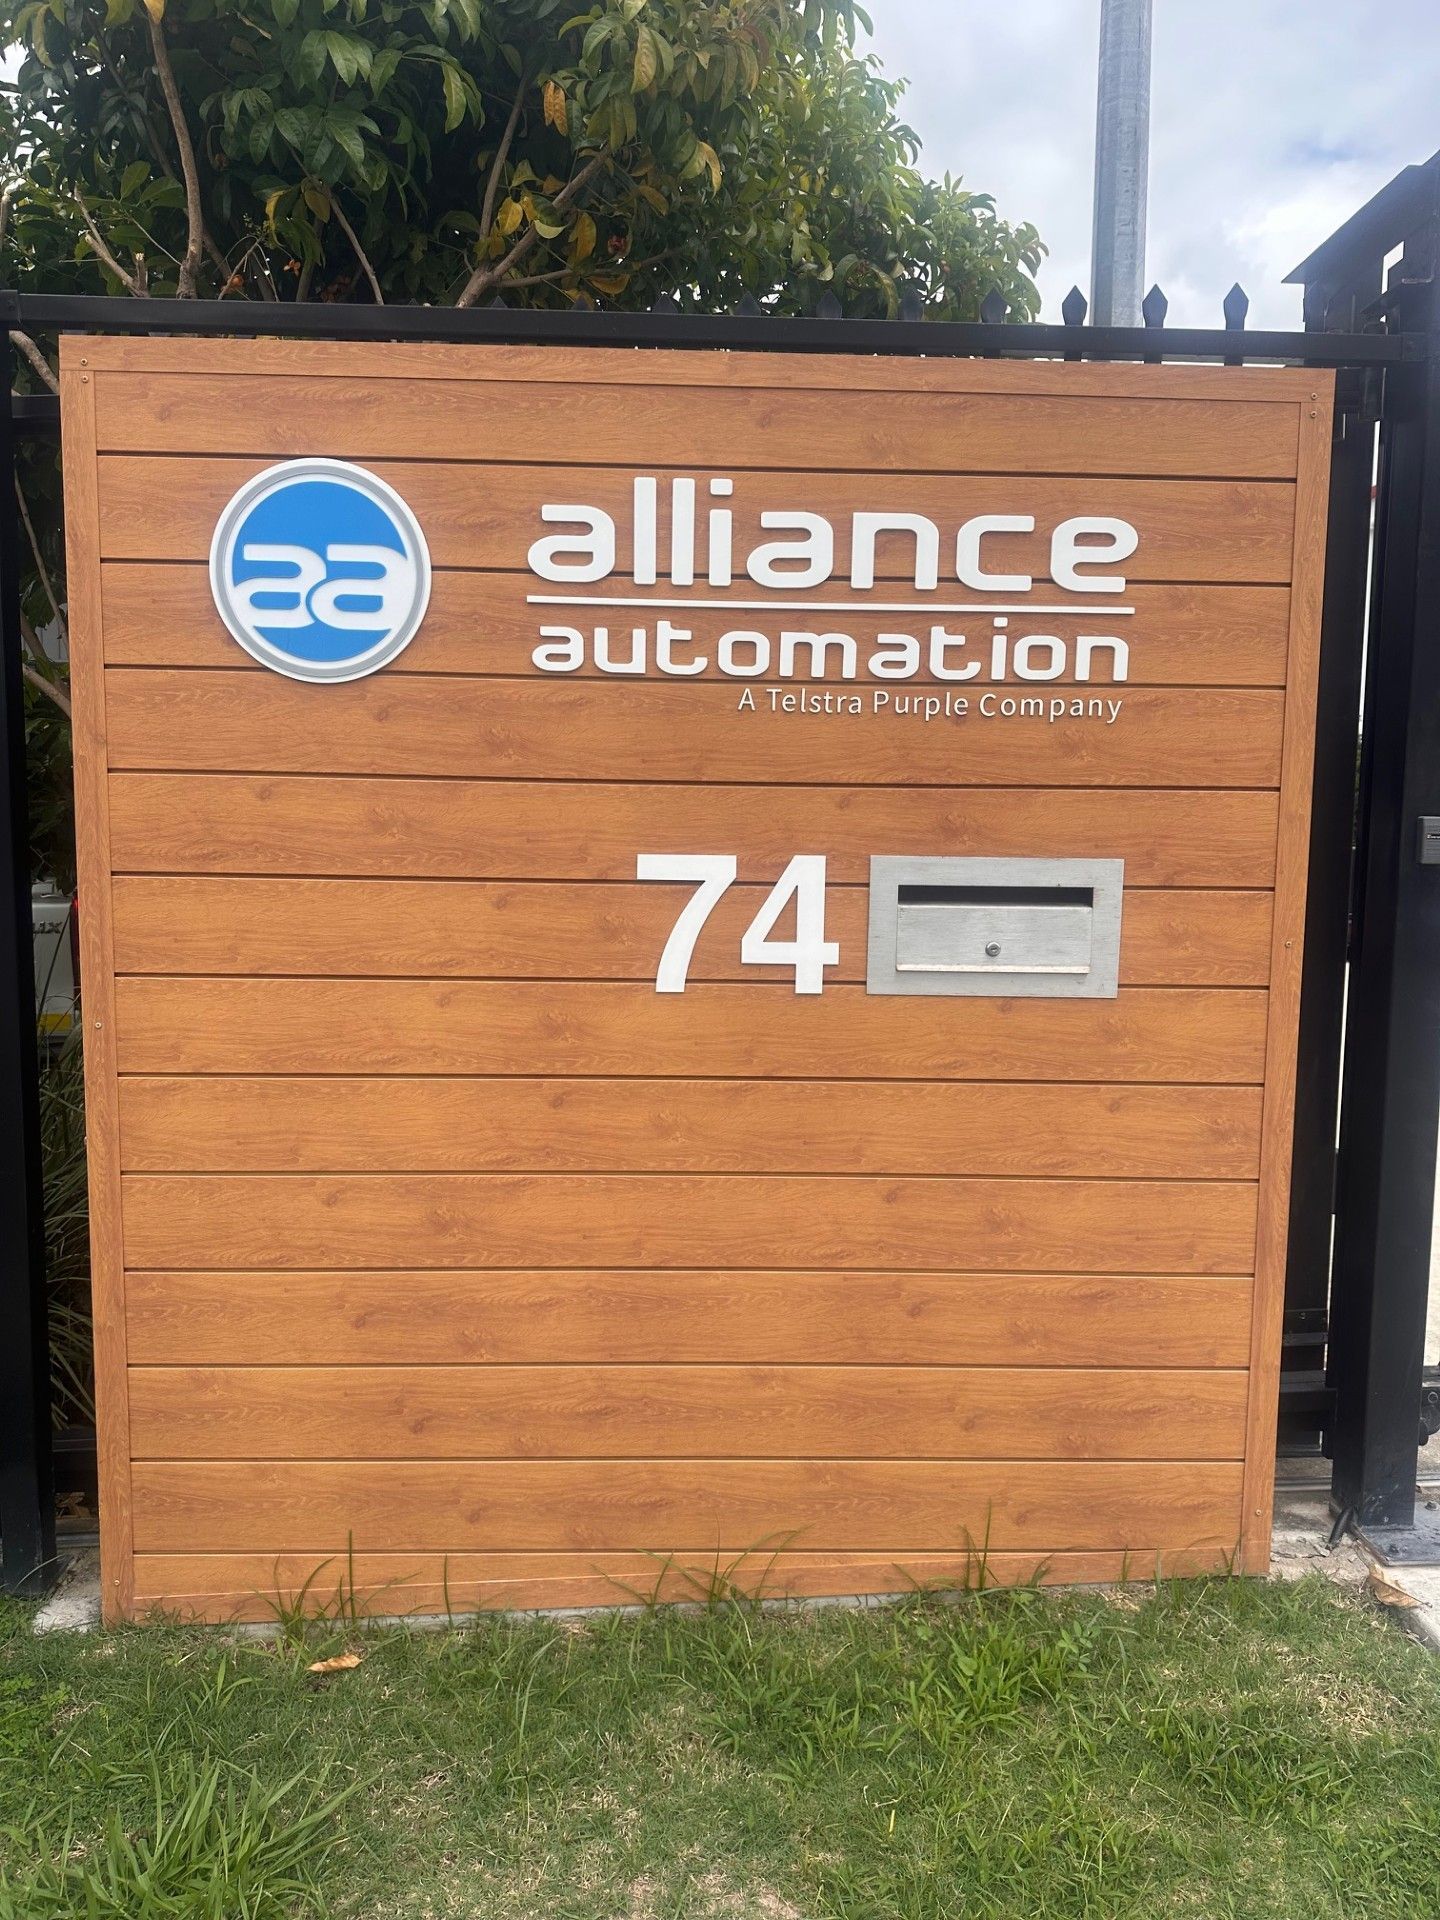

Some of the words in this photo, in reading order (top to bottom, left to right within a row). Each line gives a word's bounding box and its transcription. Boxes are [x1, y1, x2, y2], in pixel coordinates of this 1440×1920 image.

[527, 476, 1139, 593] alliance
[532, 617, 1130, 682] automation
[738, 688, 755, 710] A
[766, 688, 863, 714] Telstra
[873, 690, 970, 722] Purple
[979, 692, 1123, 724] Company
[637, 854, 840, 994] 74
